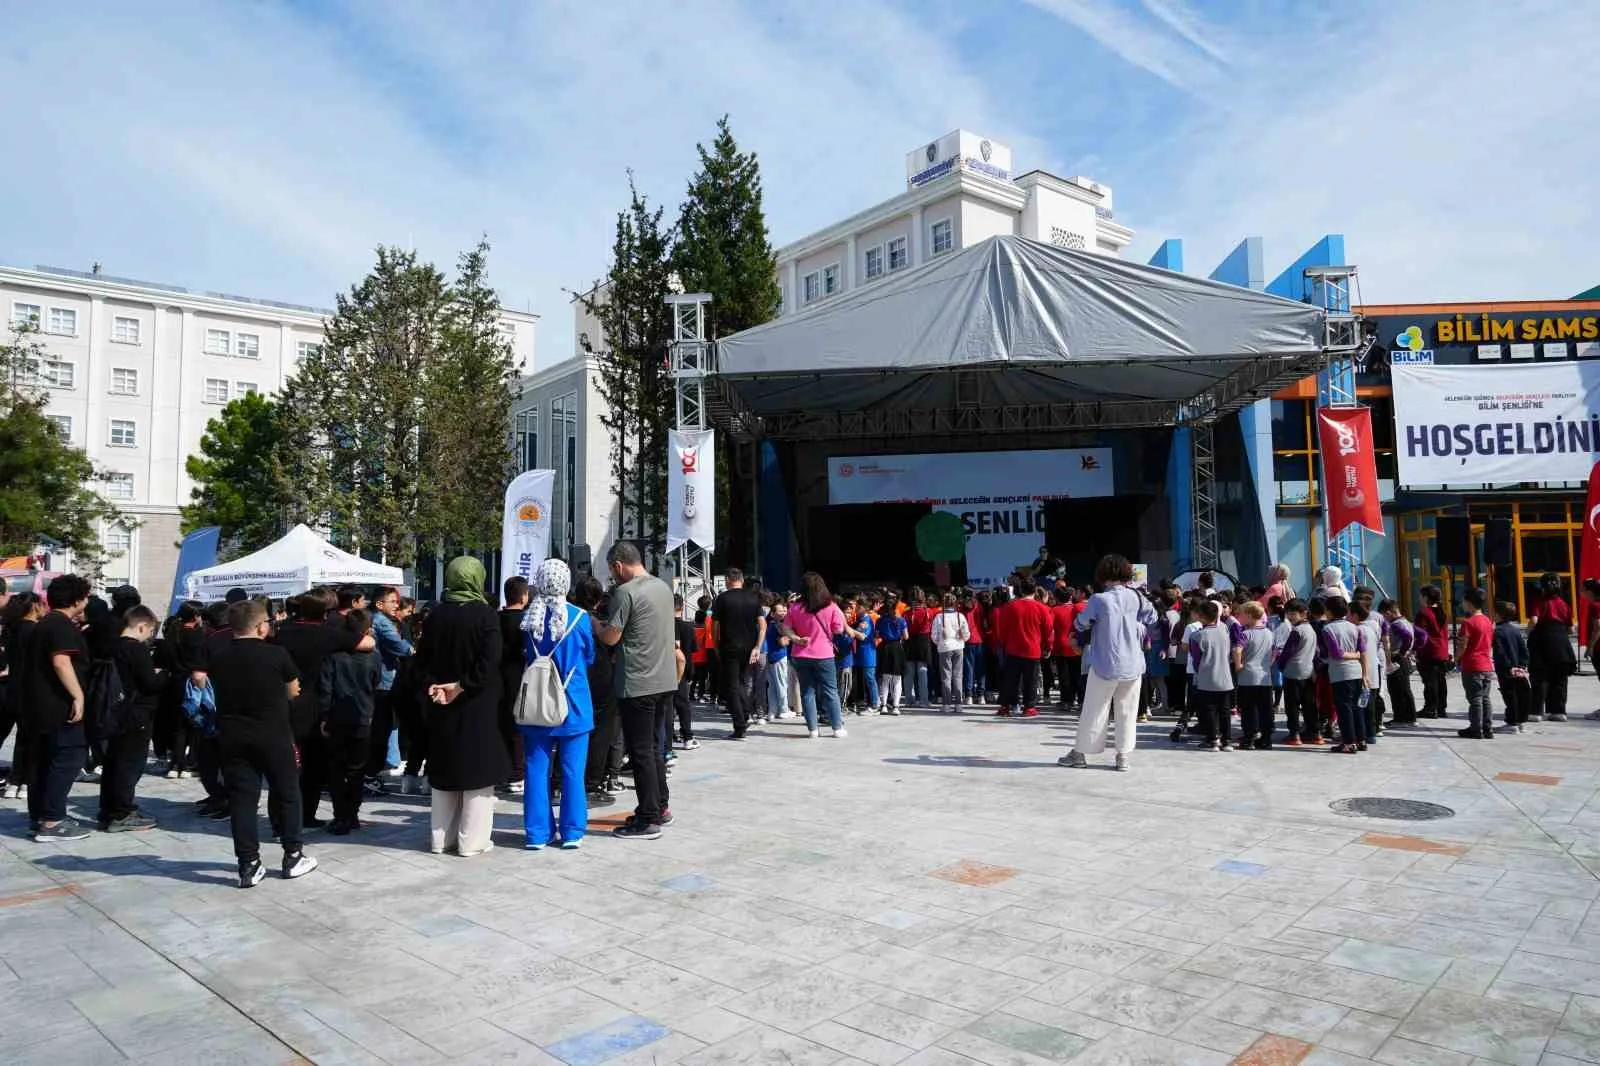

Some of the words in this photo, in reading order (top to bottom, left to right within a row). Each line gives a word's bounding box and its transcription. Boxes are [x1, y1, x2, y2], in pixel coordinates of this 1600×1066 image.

[1437, 313, 1514, 342] BİLİM
[1522, 317, 1599, 340] SAMS
[1392, 350, 1432, 362] BİLİM
[1478, 401, 1499, 410] BİLİM
